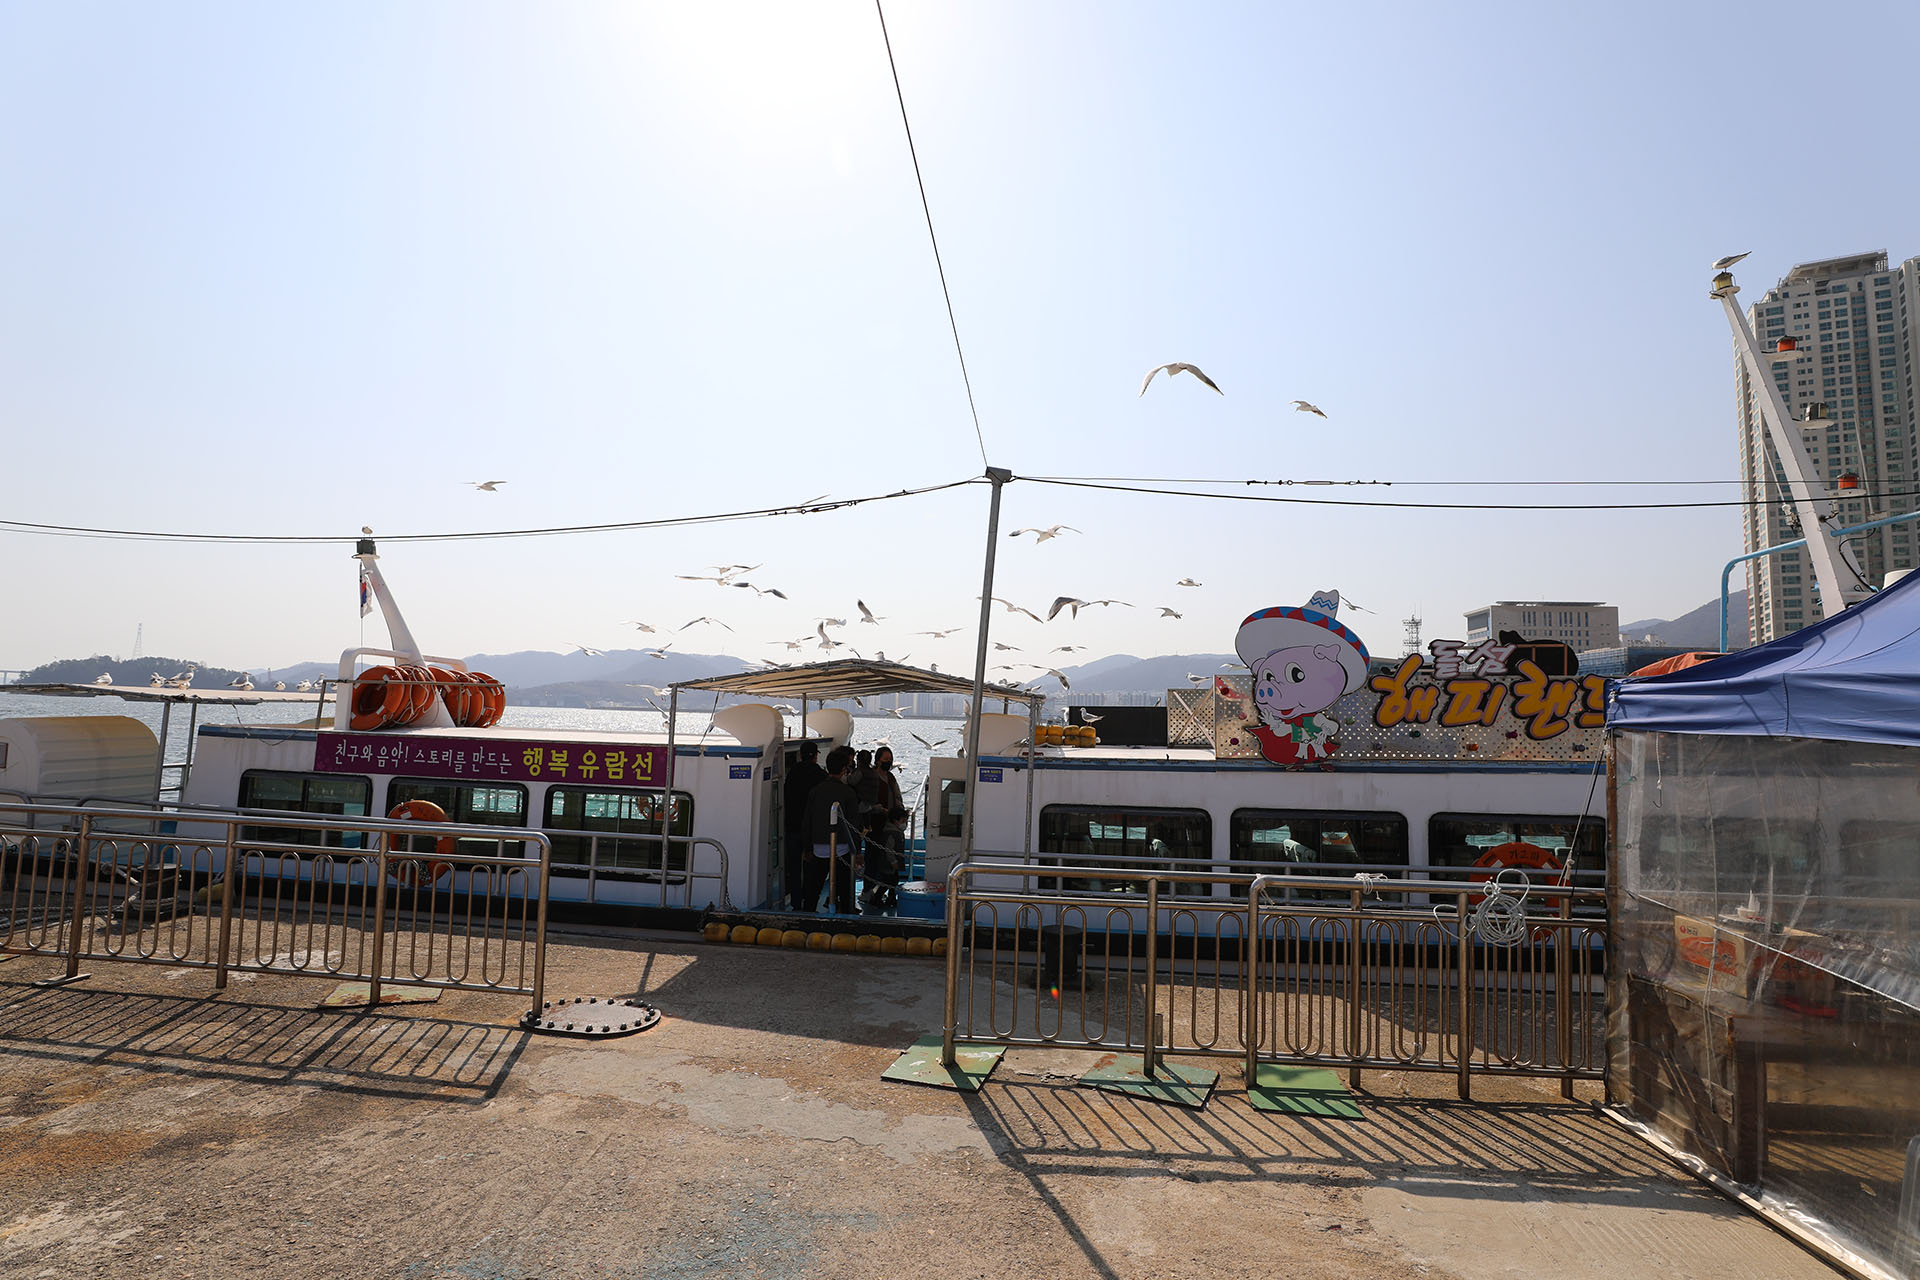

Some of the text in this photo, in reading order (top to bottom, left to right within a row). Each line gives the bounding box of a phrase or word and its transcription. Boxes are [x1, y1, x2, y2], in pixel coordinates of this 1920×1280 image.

[335, 739, 373, 765] 친구와
[377, 741, 409, 768] 음악!
[413, 749, 466, 774] 스토리를
[472, 746, 512, 774] 만드는
